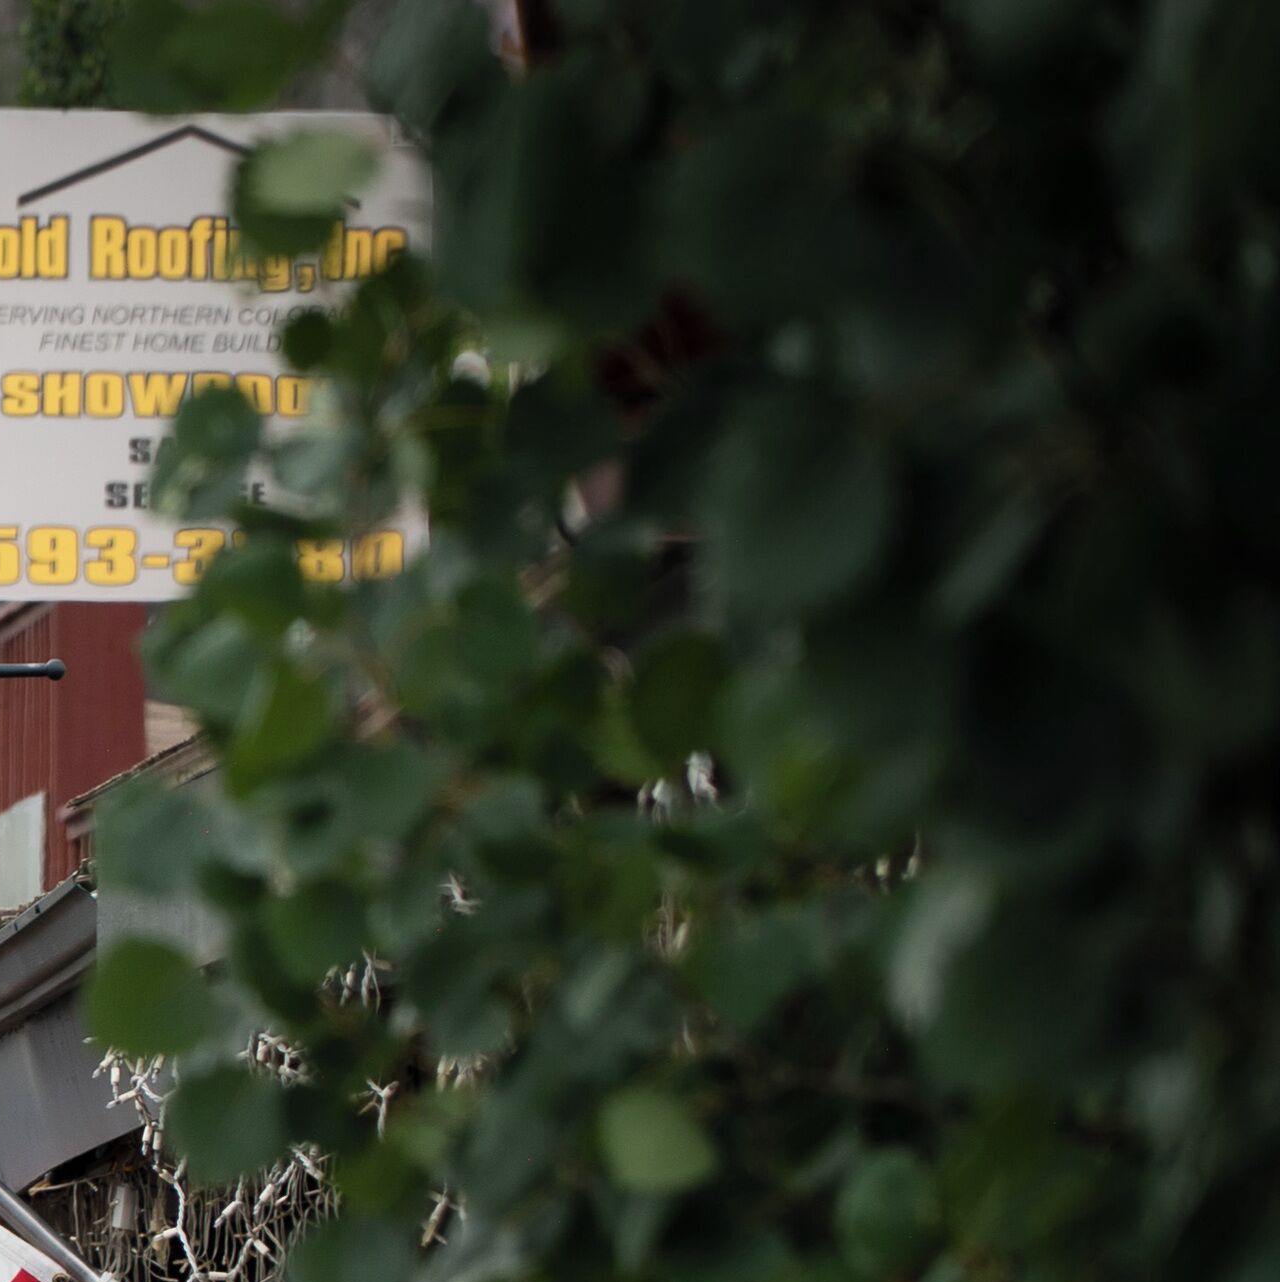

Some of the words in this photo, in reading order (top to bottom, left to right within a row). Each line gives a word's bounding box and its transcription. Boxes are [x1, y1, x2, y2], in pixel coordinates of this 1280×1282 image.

[91, 304, 231, 328] NORTHERN
[38, 332, 126, 354] FINEST
[132, 332, 207, 354] HOME
